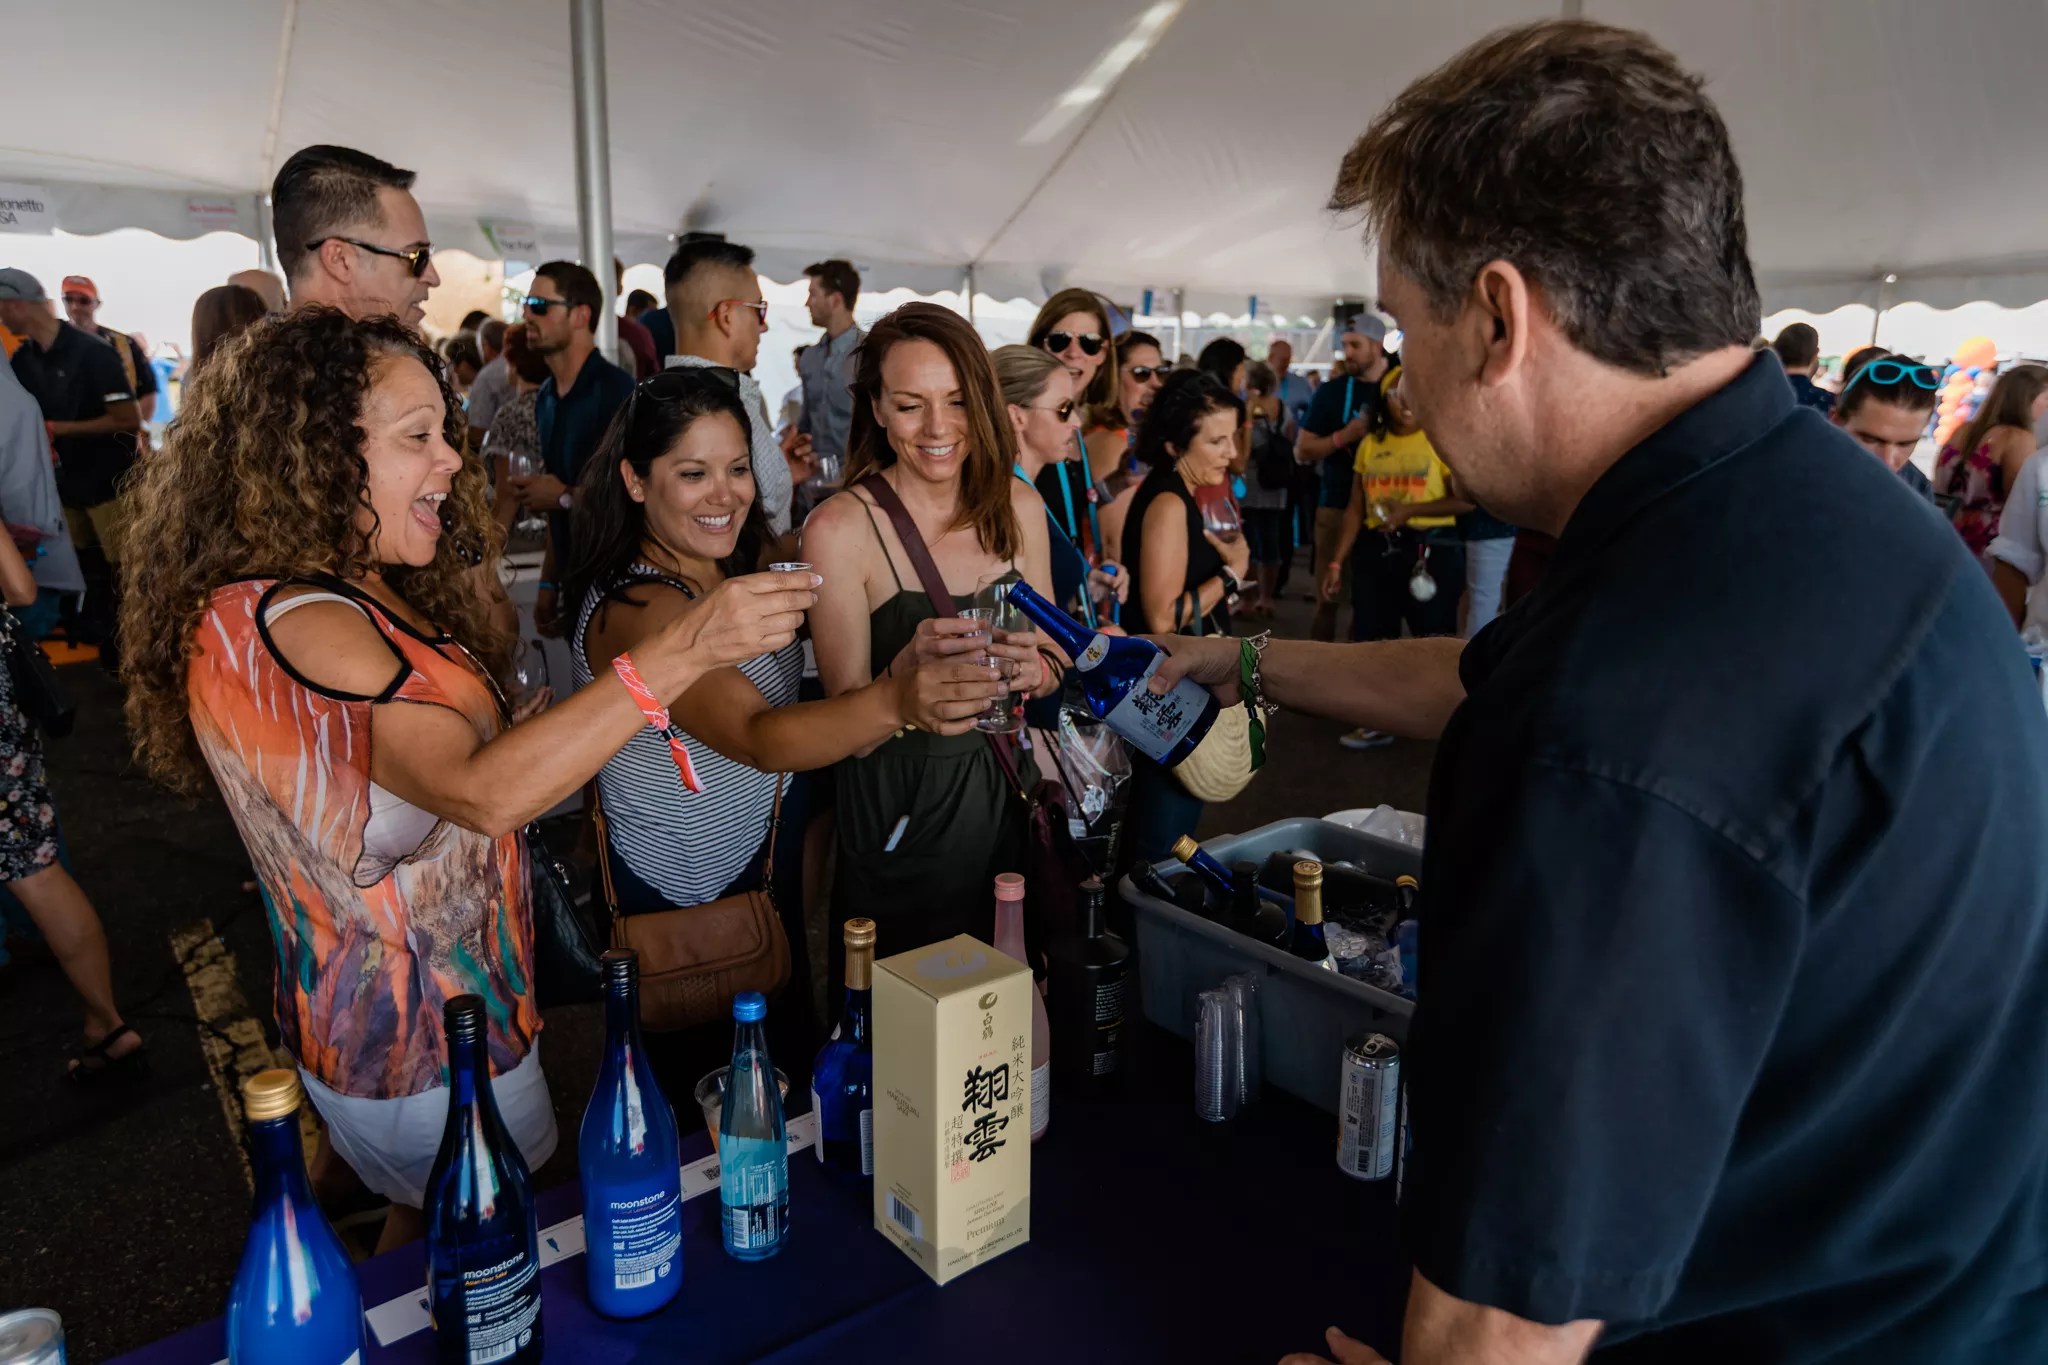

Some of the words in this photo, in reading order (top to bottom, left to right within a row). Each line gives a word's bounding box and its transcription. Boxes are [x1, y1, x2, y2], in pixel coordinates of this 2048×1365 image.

[962, 1063, 1010, 1163] 翔雲
[611, 1191, 665, 1209] moonstone
[966, 1217, 1006, 1241] Premium
[464, 1252, 525, 1280] moonstone
